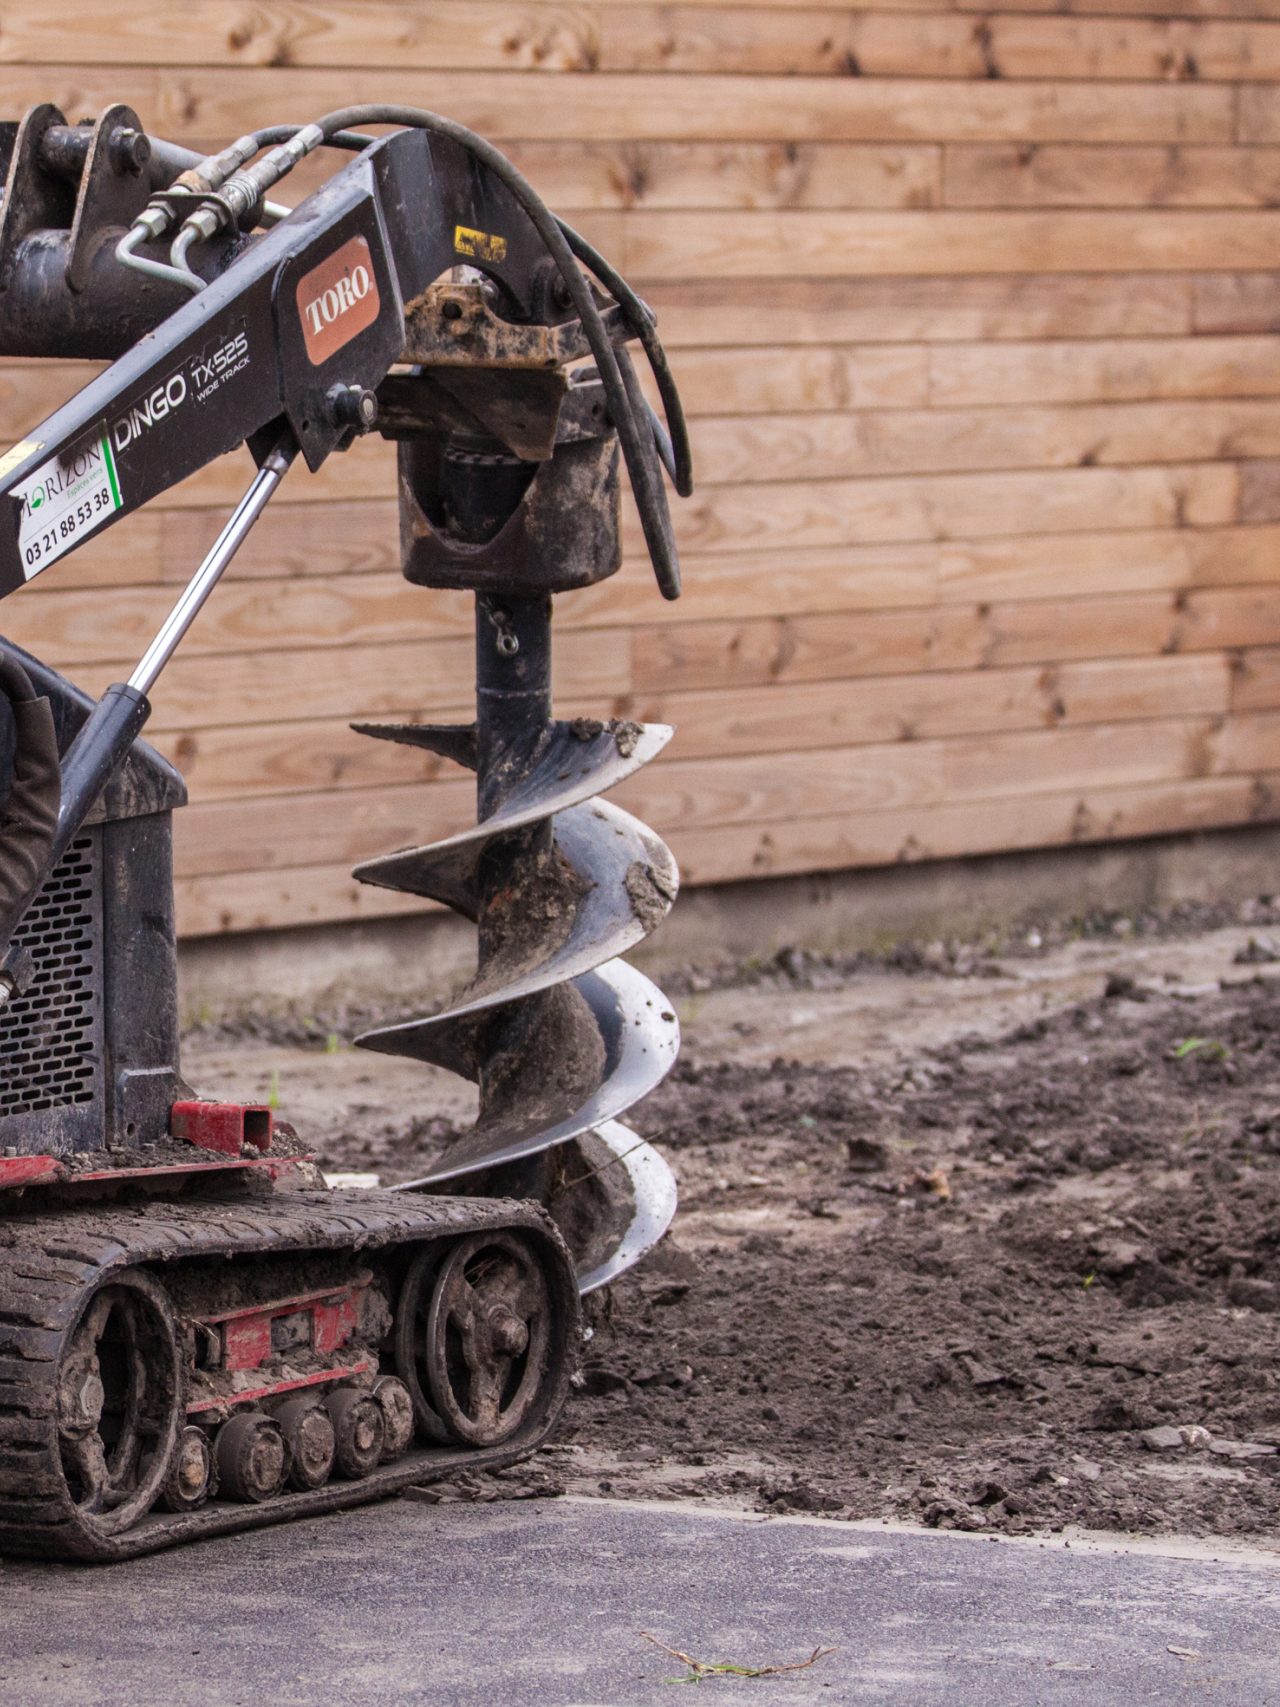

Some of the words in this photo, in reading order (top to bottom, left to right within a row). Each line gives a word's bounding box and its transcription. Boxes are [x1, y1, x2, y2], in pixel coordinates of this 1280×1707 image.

[306, 265, 369, 336] TORO
[114, 374, 187, 452] DINGO
[197, 380, 219, 402] WIDE
[220, 355, 251, 384] TRACK
[26, 542, 42, 565] 03
[42, 529, 58, 552] 21
[60, 515, 76, 538] 88
[77, 502, 93, 525] 53
[94, 487, 110, 512] 38
